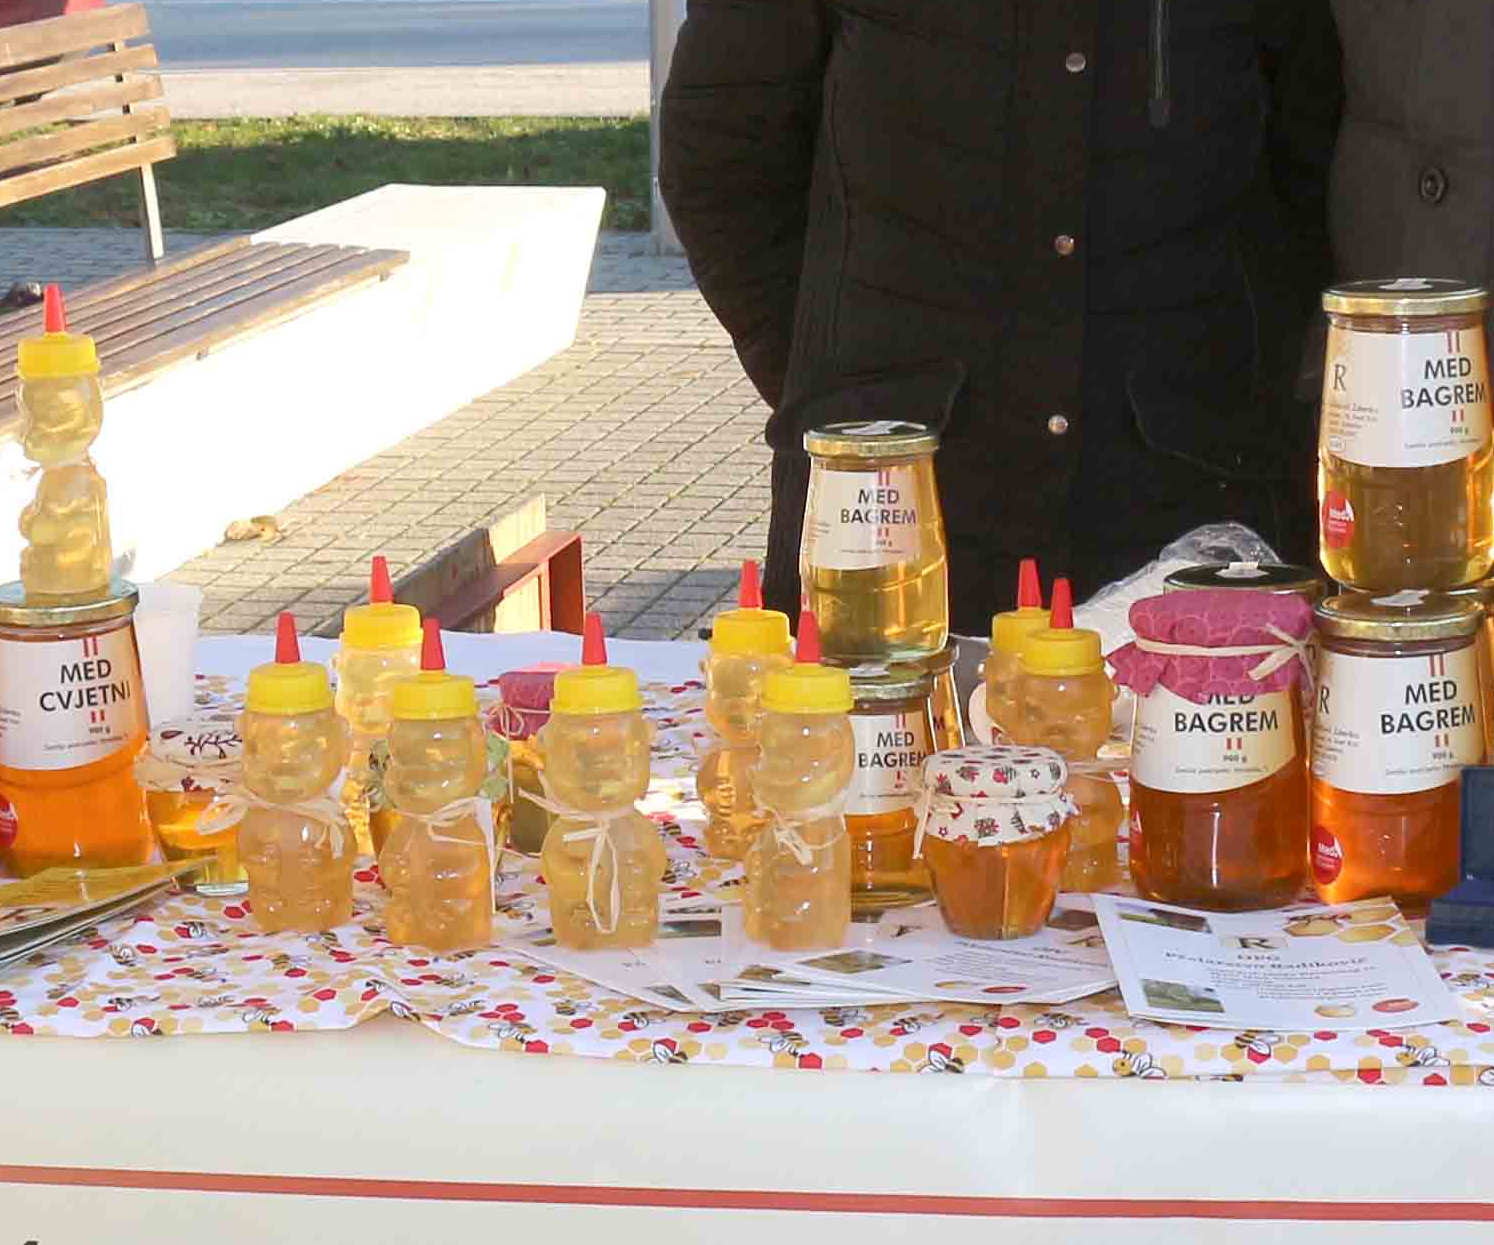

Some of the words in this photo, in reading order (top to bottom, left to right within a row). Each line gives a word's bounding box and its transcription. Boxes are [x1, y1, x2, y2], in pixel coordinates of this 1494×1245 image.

[1333, 364, 1347, 392] R
[1424, 357, 1471, 380] MED
[1401, 382, 1485, 409] BAGREM
[858, 489, 900, 504] MED
[841, 508, 916, 524] BAGREM
[60, 659, 112, 684] MED
[39, 680, 131, 712] CVJETNI
[1319, 684, 1330, 715] R
[1405, 680, 1457, 705] MED
[1174, 710, 1278, 733] BAGREM
[1380, 704, 1475, 735] BAGREM
[877, 732, 915, 748] MED
